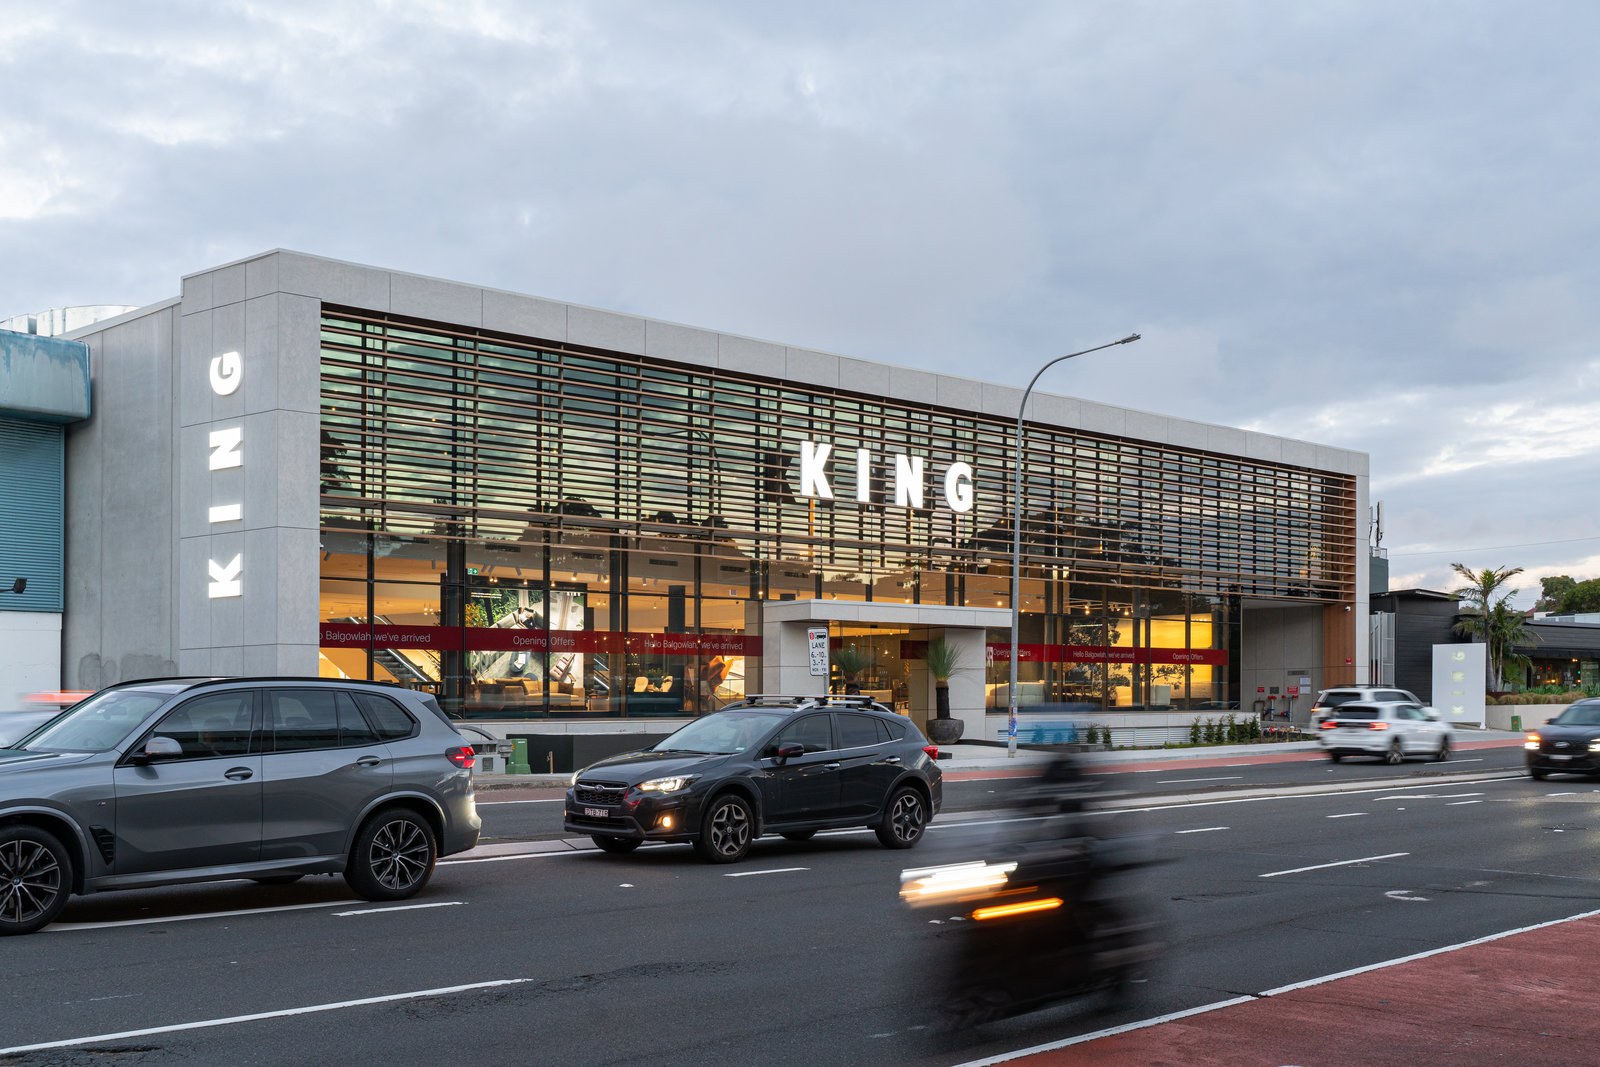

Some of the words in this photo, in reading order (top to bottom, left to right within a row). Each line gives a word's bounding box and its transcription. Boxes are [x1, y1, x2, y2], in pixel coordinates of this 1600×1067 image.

[207, 351, 243, 598] KING
[801, 441, 973, 512] KING
[374, 633, 399, 642] we've
[401, 634, 431, 642] arrived
[513, 635, 547, 647] Opening
[550, 636, 575, 646] Offers
[644, 640, 662, 648] Hello
[721, 642, 743, 650] arrived
[993, 648, 1011, 657] Openin
